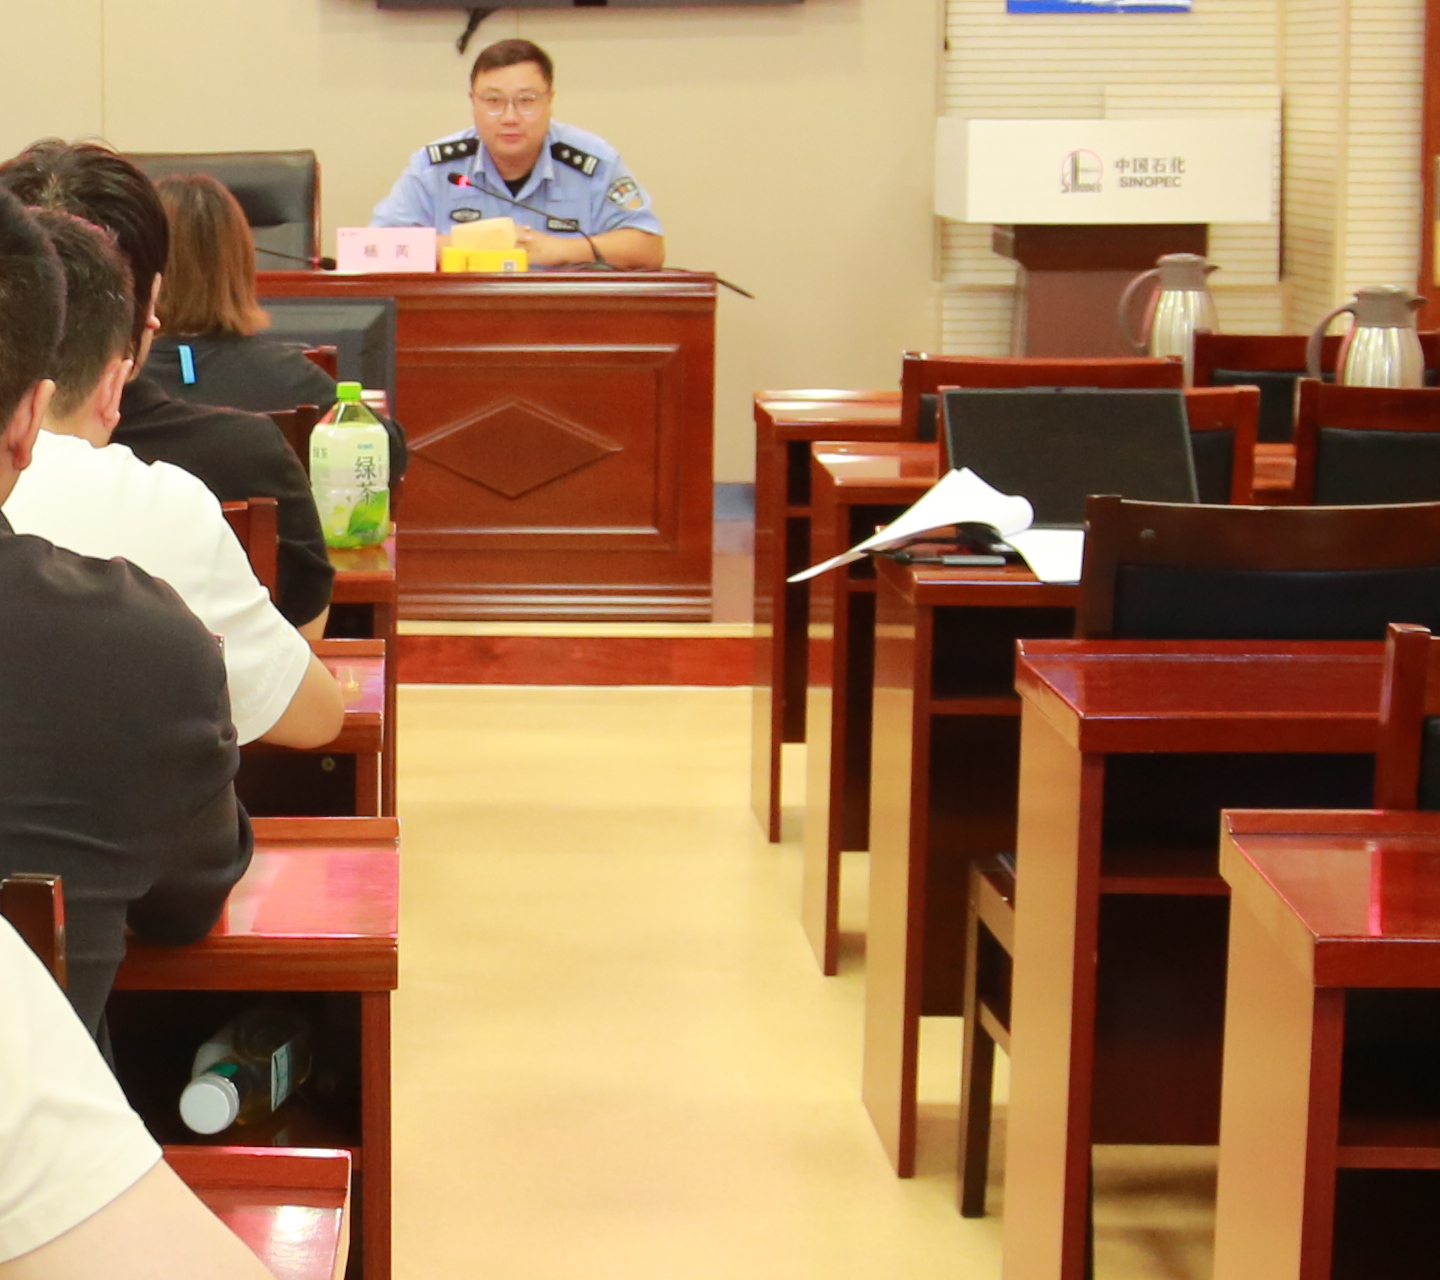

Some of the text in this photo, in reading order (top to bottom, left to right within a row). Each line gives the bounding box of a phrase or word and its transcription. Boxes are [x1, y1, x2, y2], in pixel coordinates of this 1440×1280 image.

[1115, 157, 1186, 173] 中国石化
[1120, 176, 1181, 187] SINOPEC
[355, 456, 377, 506] 绿茶
